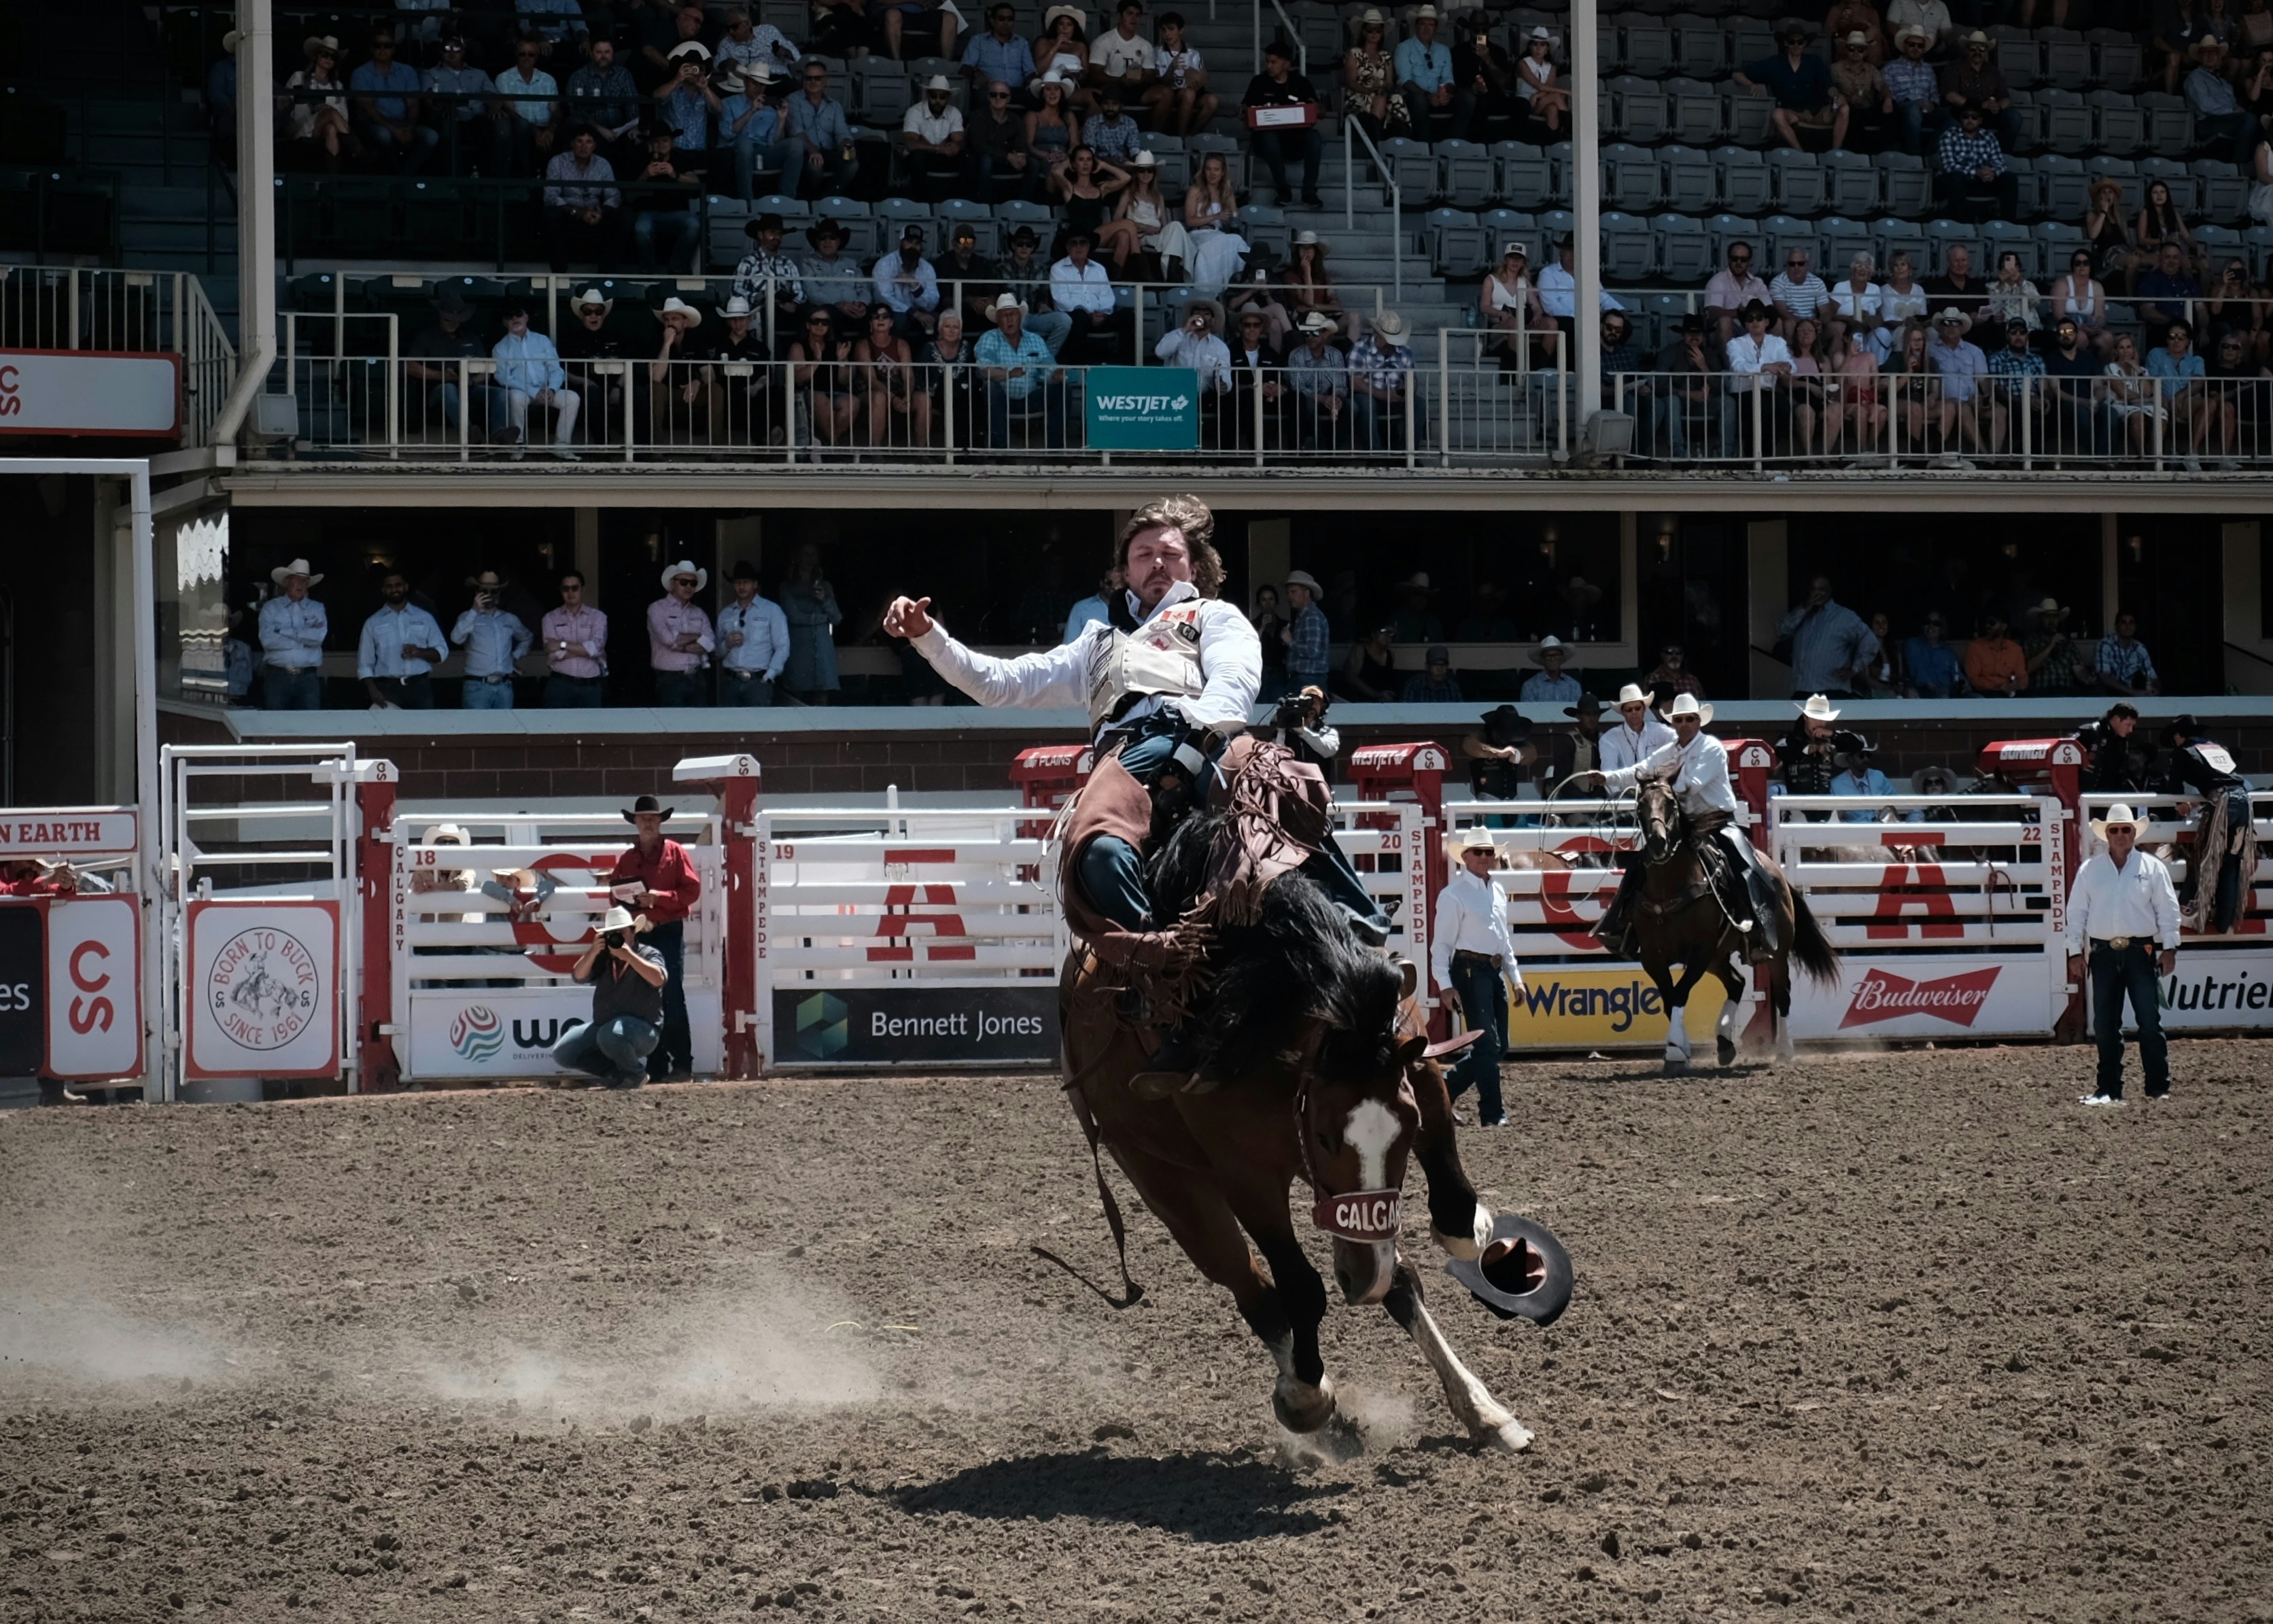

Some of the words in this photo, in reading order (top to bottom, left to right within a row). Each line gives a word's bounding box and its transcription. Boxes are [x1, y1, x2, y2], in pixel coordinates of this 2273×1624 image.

[1096, 396, 1170, 415] WESTJET
[1039, 754, 1073, 767] PLAINS
[1351, 750, 1398, 771] WESTJET
[18, 823, 101, 843] EARTH
[1381, 834, 1402, 849] 20
[2022, 827, 2041, 842] 22
[415, 850, 436, 866] 18
[775, 844, 795, 860] 19
[1411, 831, 1425, 944] STAMPEDE
[2050, 823, 2064, 933] STAMPEDE
[395, 846, 404, 951] CALGARY
[757, 842, 767, 958] STAMPEDE
[213, 938, 249, 985] BORN
[254, 932, 275, 950] TO
[280, 939, 314, 986] BUCK
[1850, 980, 1988, 1010] Budweiser
[2167, 971, 2273, 1010] utrie
[1524, 980, 1666, 1033] Wrangle
[224, 1012, 263, 1045] SINCE
[272, 1012, 303, 1042] 1961
[871, 1012, 968, 1037] Bennett
[975, 1010, 1043, 1042] Jones
